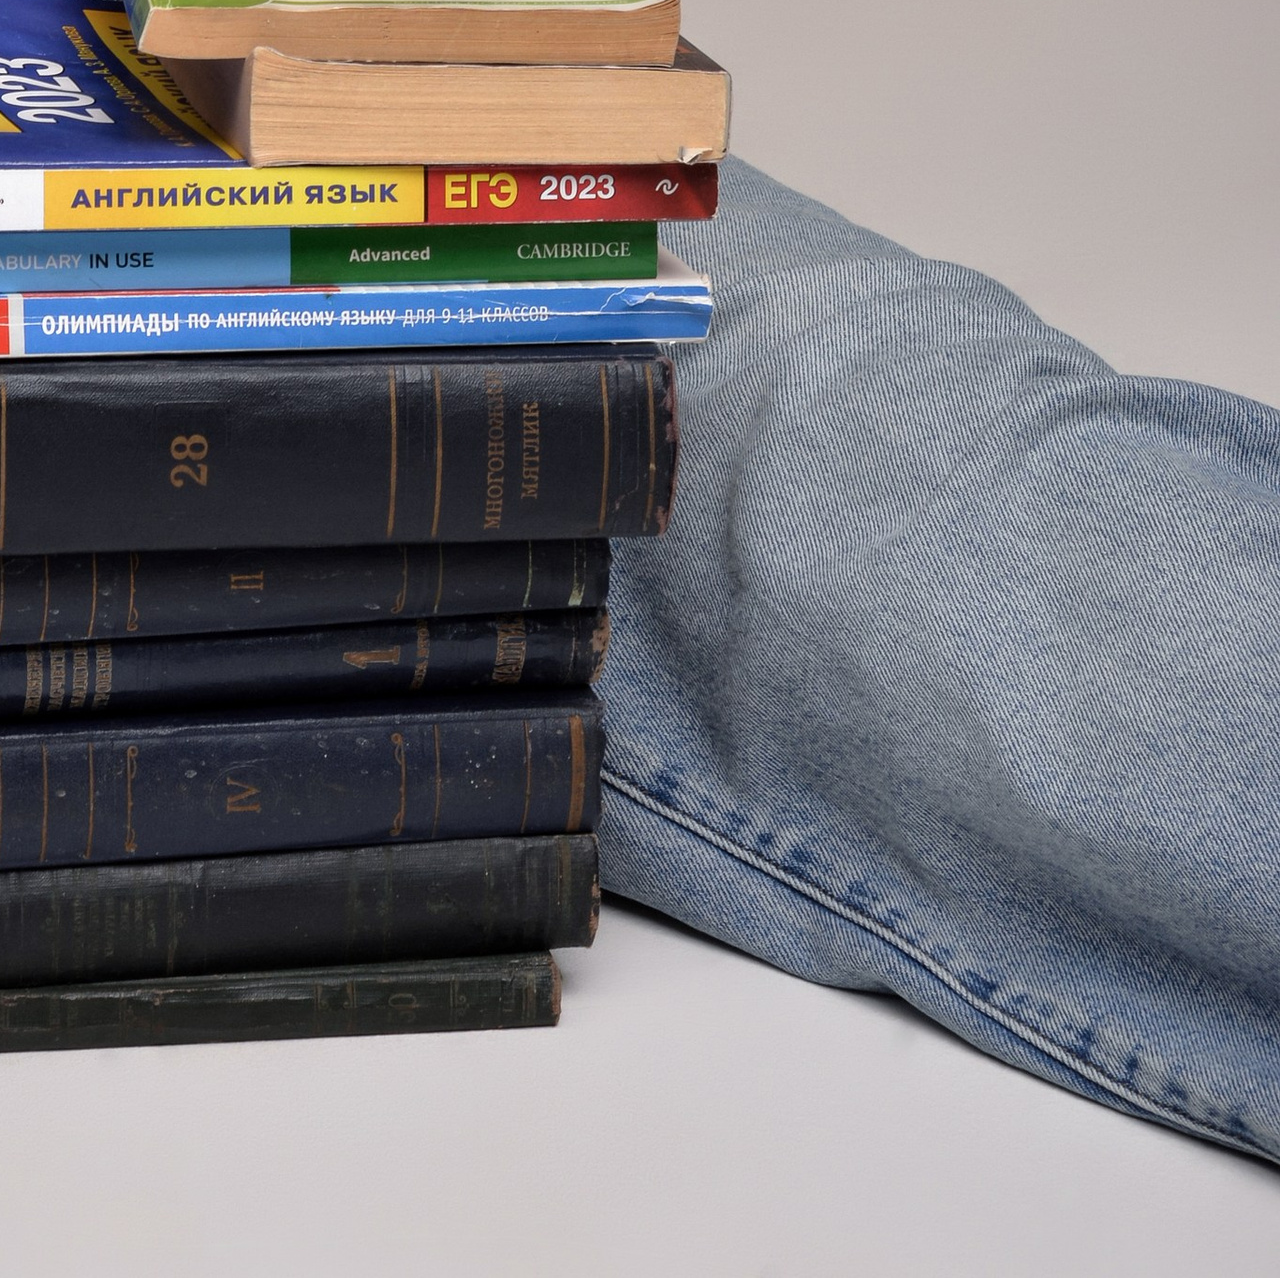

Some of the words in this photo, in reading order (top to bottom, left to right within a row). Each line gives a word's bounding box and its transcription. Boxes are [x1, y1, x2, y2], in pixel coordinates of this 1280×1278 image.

[71, 181, 294, 209] АНГЛИЙСКИЙ
[304, 183, 399, 205] ЯЗЫК
[444, 172, 518, 210] ЕГЭ
[539, 174, 616, 201] 2023
[88, 253, 112, 269] IN
[115, 252, 154, 269] USE
[349, 245, 431, 263] Advanced
[517, 241, 631, 260] CAMBRIDGE
[41, 313, 180, 337] ОЛИМПИАДЫ
[188, 313, 210, 329] ПО
[216, 309, 335, 328] АНГЛИЙСКОМУ
[340, 309, 397, 326] ЯЗЫКУ
[402, 309, 435, 328] ДЛЯ
[481, 306, 550, 324] КЛАССОВ
[169, 433, 209, 488] 28
[521, 401, 541, 500] МЯТЛИК
[342, 645, 401, 669] 1
[226, 776, 262, 814] IV
